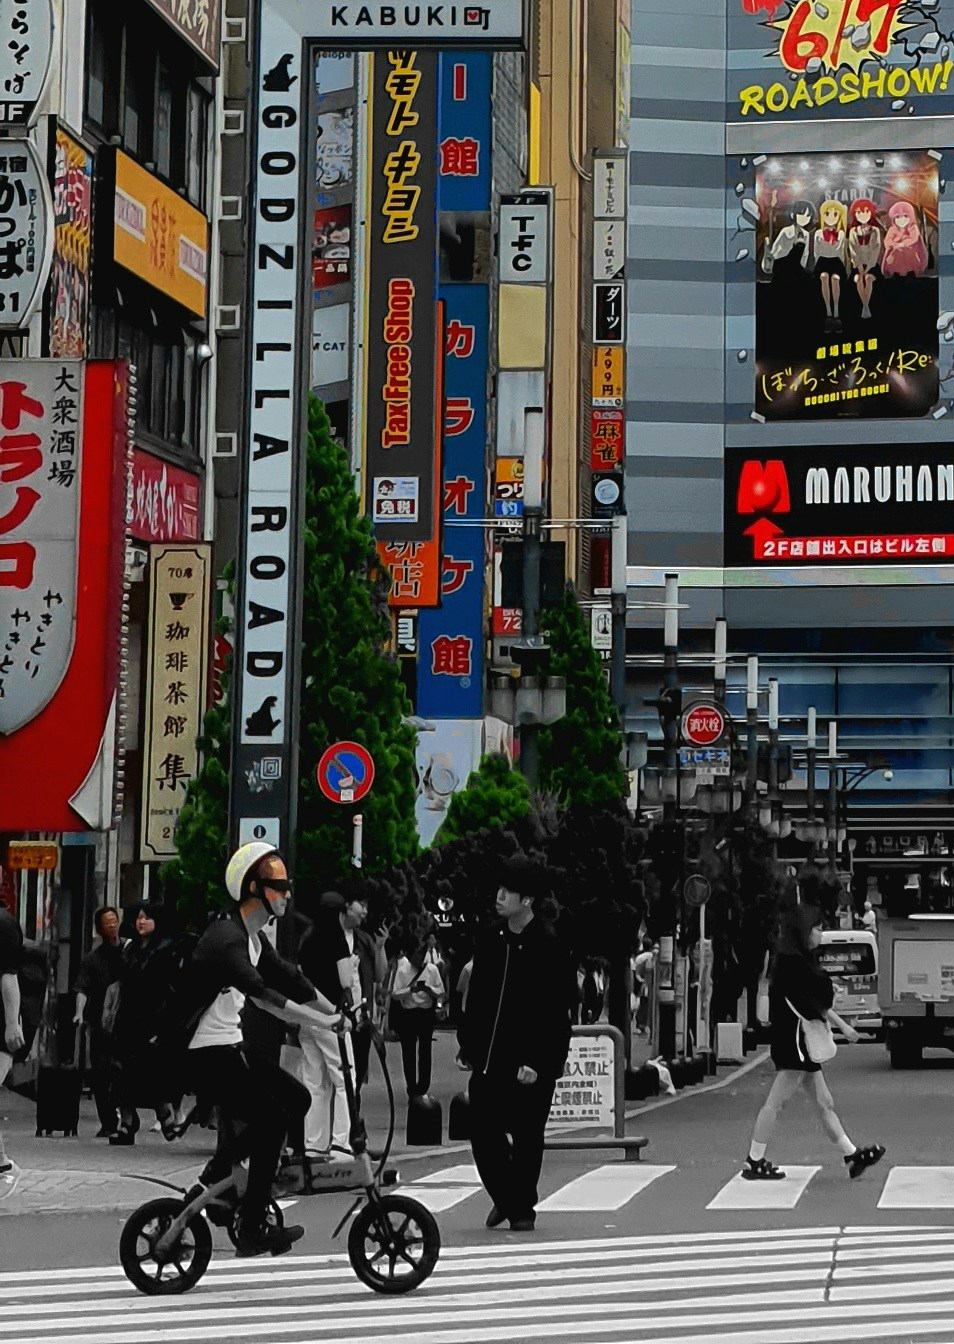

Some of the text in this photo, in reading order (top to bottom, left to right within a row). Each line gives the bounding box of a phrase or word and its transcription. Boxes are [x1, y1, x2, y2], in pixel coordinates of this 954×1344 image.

[331, 5, 491, 30] KABUKI町
[739, 60, 954, 116] ROADSHOW!
[605, 286, 621, 330] ダーツ
[246, 103, 297, 675] GODZILLA ROAD
[382, 278, 413, 448] Tax Free Shop
[46, 366, 79, 488] 大衆酒場
[592, 421, 621, 463] 麻雀
[431, 318, 476, 676] カラオケ館
[805, 464, 954, 505] MARUHAN
[30, 589, 63, 679] やきとり
[164, 623, 190, 739] 珈琲茶館
[154, 753, 192, 792] 集
